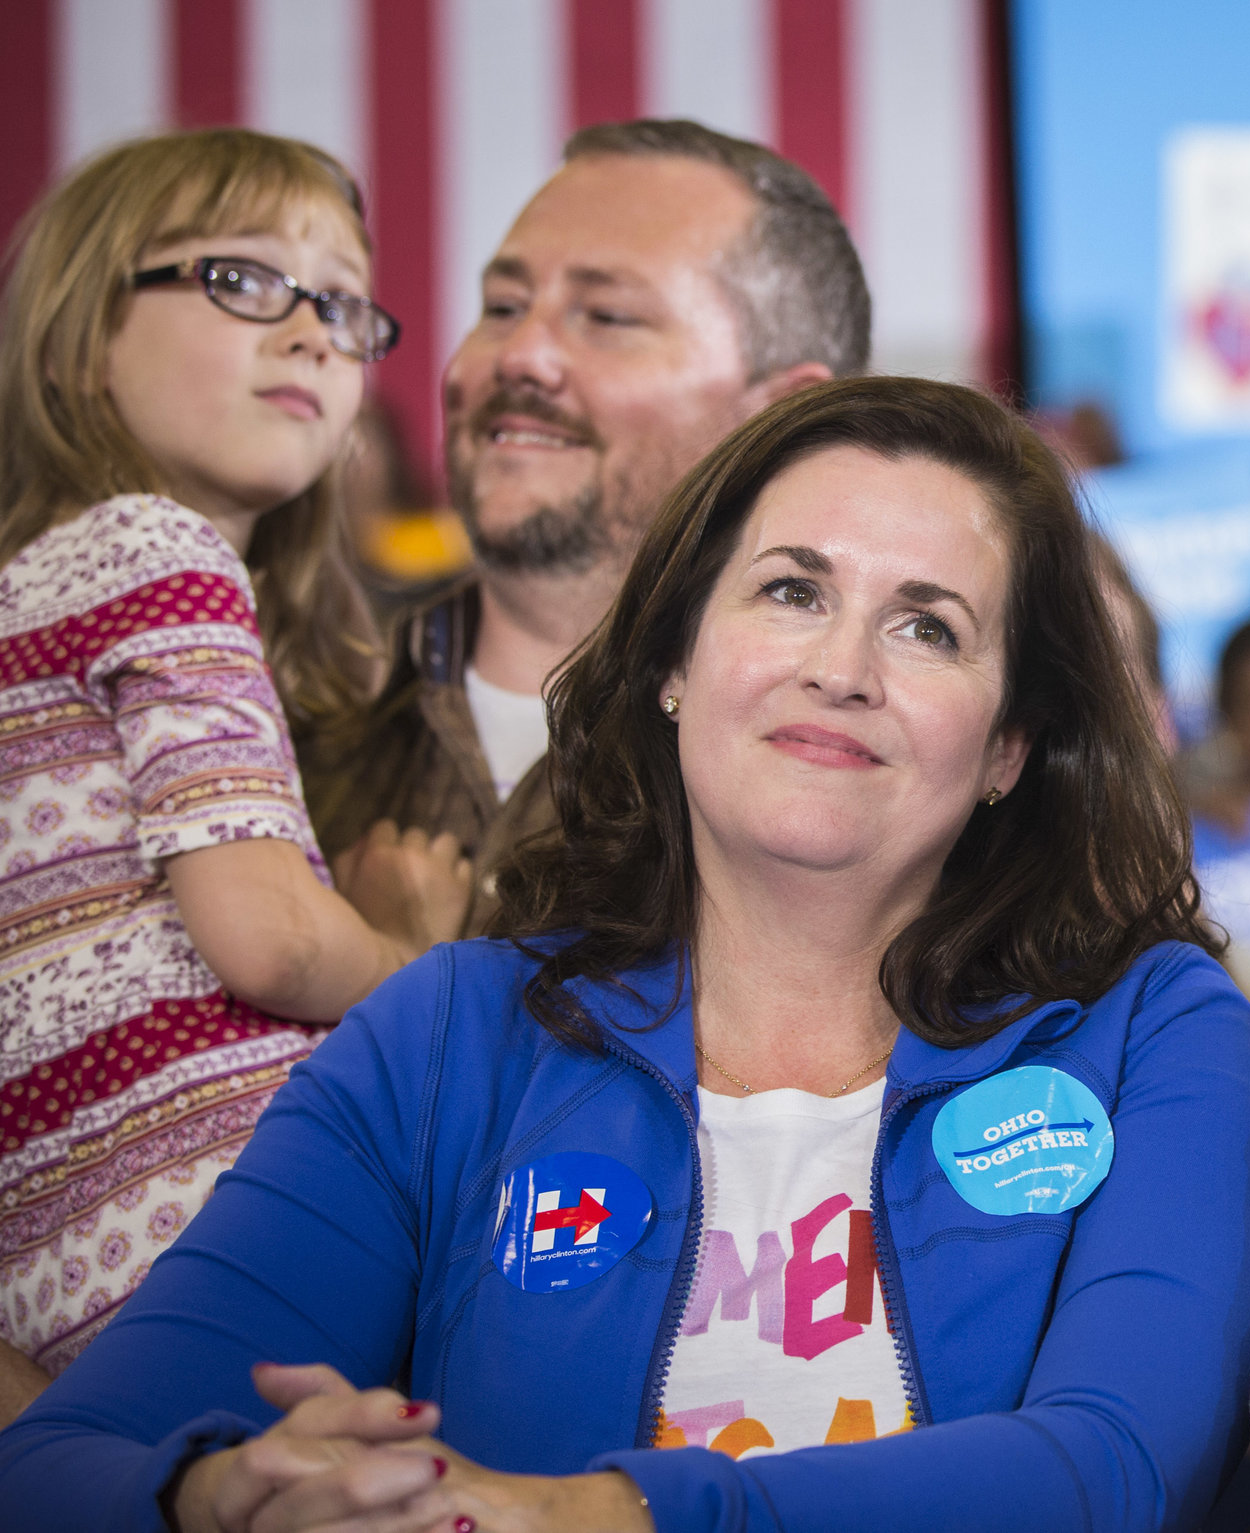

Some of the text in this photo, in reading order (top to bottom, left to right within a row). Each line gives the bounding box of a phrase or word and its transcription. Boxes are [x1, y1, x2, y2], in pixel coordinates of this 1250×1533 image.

[983, 1109, 1046, 1142] OHIO
[955, 1131, 1089, 1174] TOGETHER
[530, 1247, 597, 1263] hillaryclinton.com
